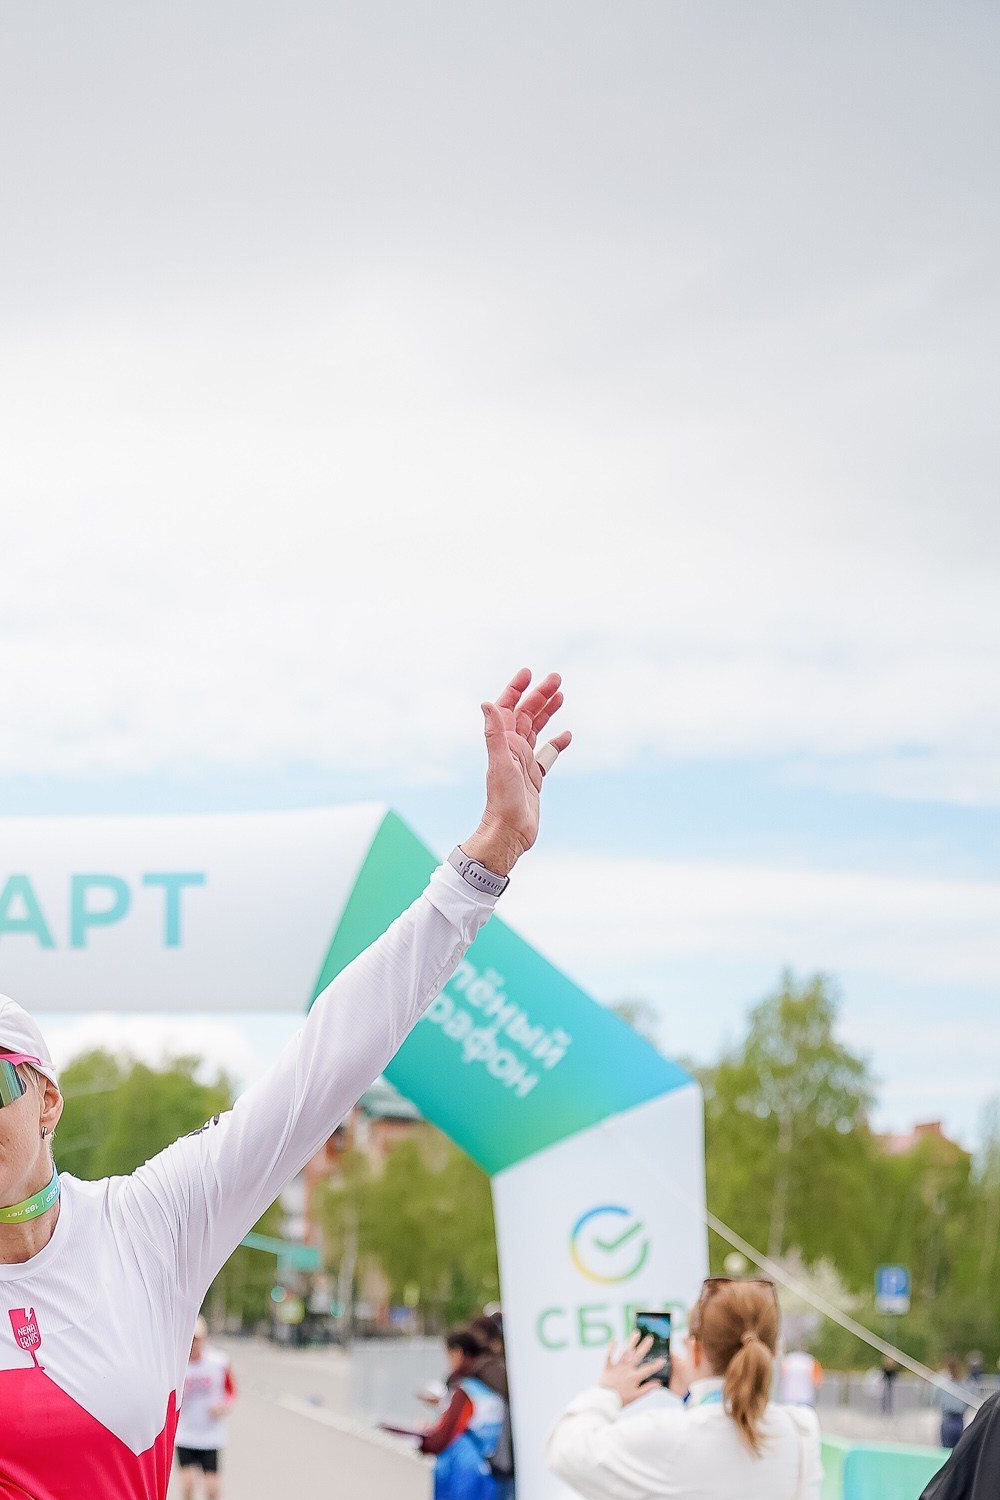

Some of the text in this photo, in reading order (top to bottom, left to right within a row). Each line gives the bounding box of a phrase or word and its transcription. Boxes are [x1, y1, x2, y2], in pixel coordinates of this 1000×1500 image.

[426, 992, 541, 1099] рафон
[450, 959, 572, 1069] лёный
[25, 1203, 39, 1215] 185
